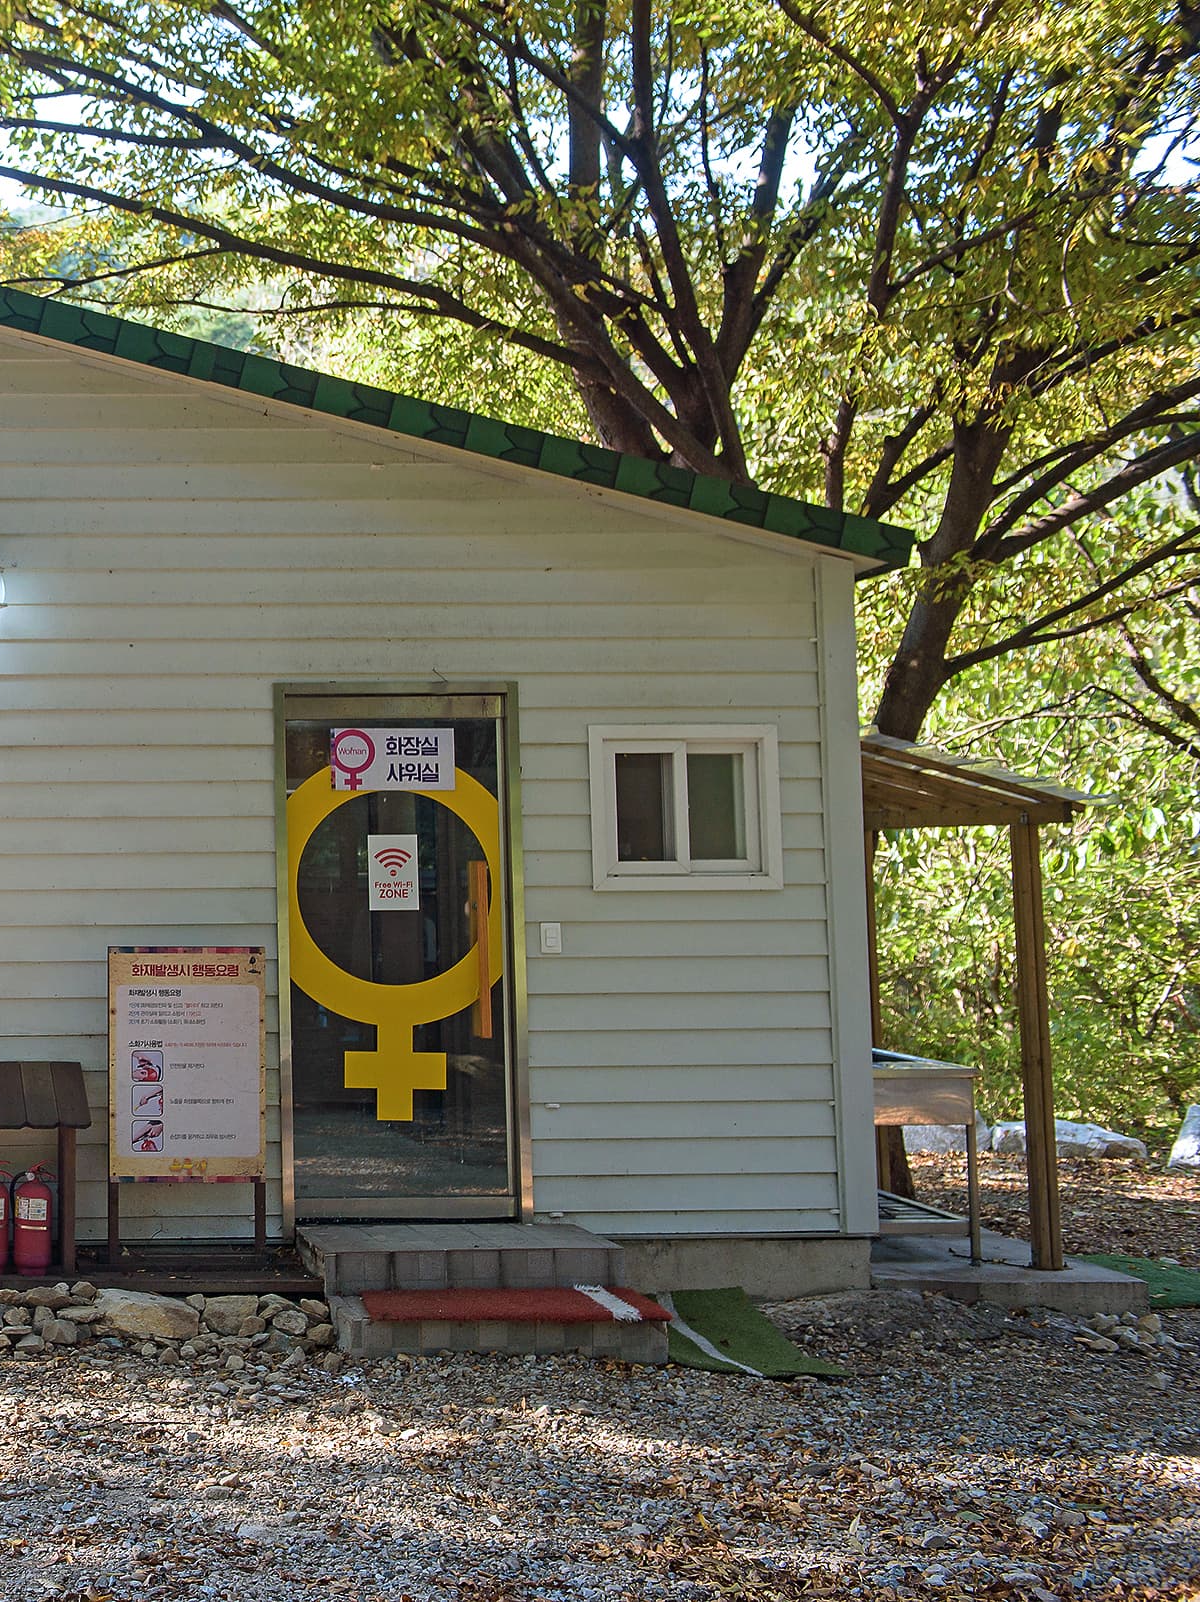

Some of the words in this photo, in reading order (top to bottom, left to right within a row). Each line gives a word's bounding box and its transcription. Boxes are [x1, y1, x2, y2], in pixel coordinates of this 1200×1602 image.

[338, 746, 367, 756] Woman
[385, 735, 439, 756] 화장실
[386, 762, 440, 783] 샤워실
[374, 881, 392, 889] Free
[393, 880, 413, 888] Wi-Fi
[379, 889, 409, 899] ZONE
[131, 963, 190, 977] 화재발생시
[192, 963, 240, 977] 행동요령
